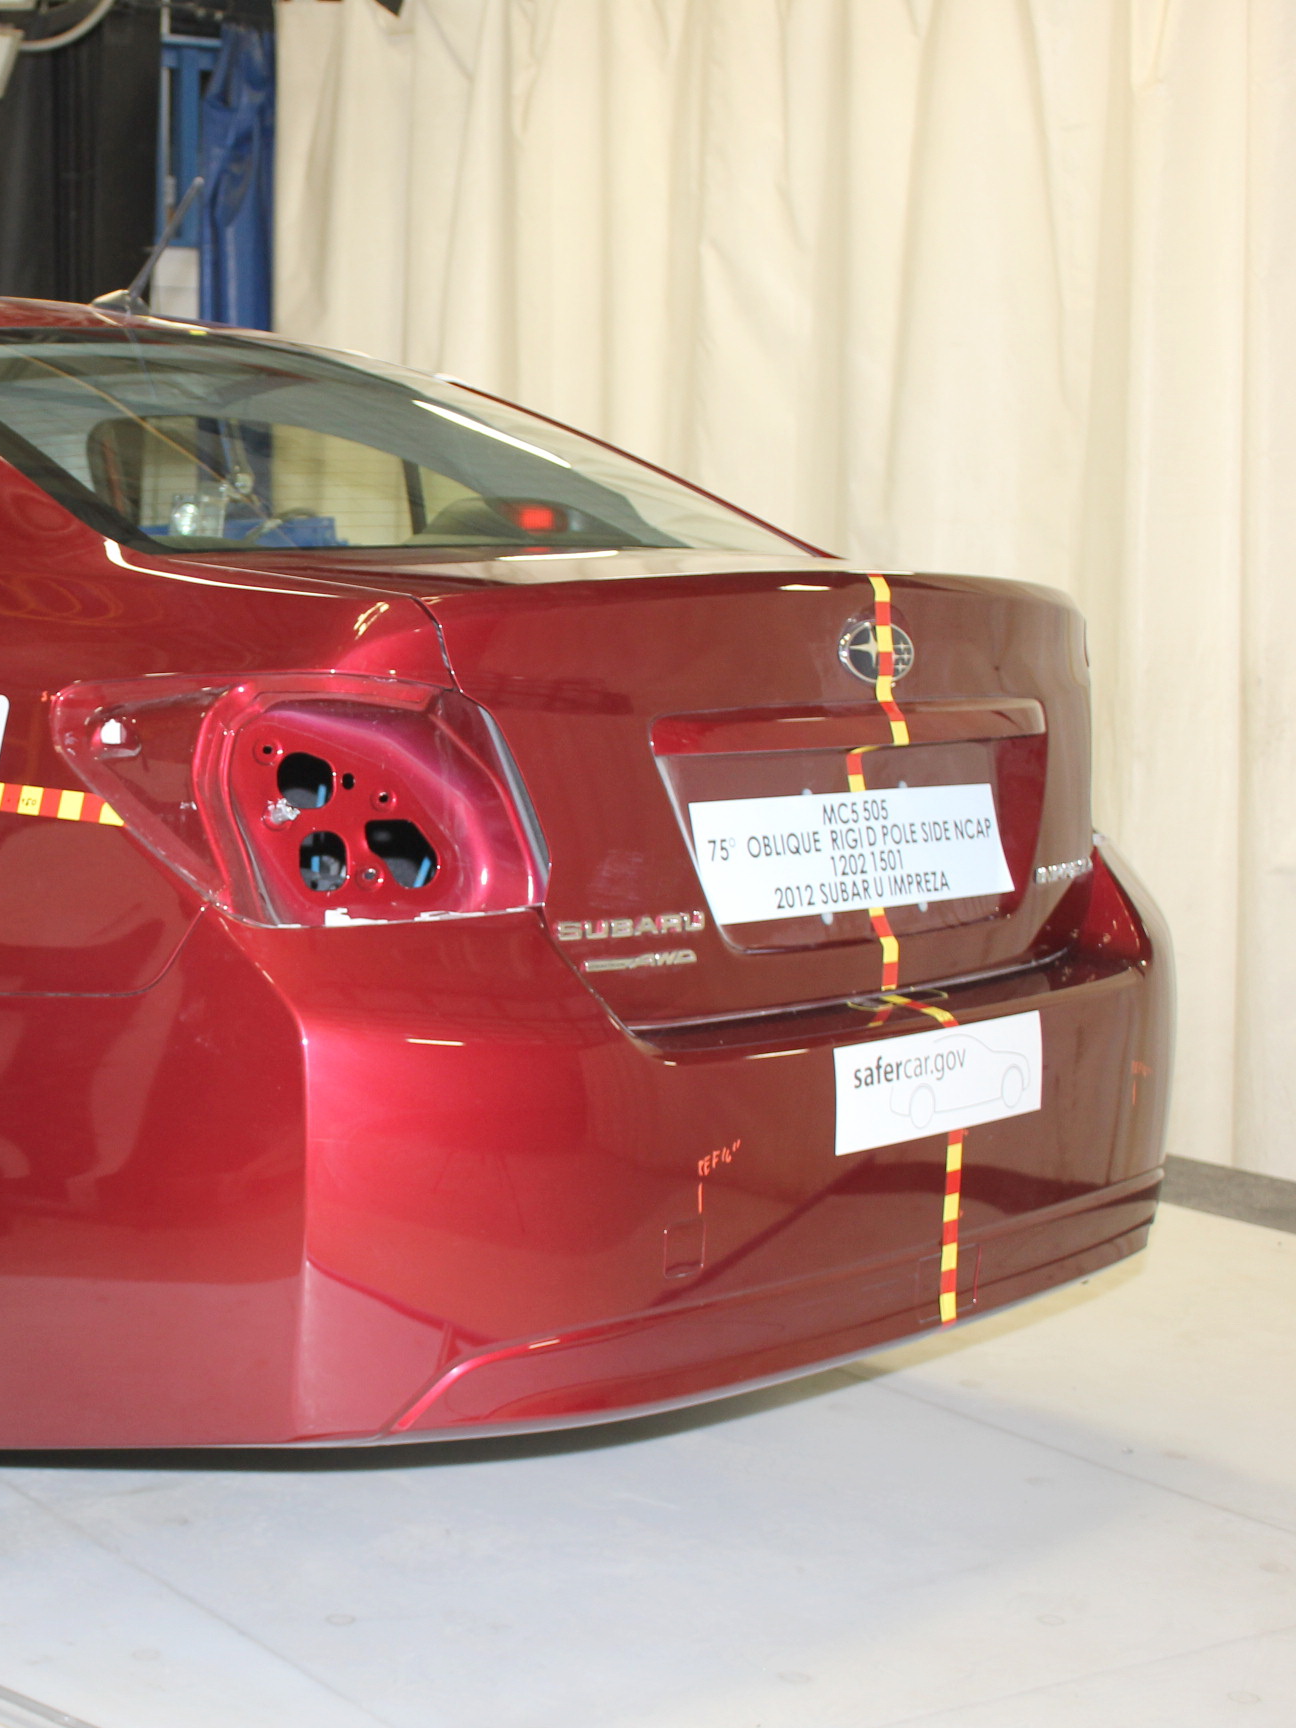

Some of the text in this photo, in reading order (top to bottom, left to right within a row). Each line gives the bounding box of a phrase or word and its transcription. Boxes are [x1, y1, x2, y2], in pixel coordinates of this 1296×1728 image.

[747, 830, 822, 858] OBLIQUE
[882, 822, 917, 847] POLE
[921, 819, 951, 843] SIDE
[954, 817, 992, 841] NCAP
[774, 884, 816, 909] 2012
[889, 870, 951, 897] IMPREZA
[557, 910, 705, 942] SUBARU
[628, 949, 698, 970] AWD
[853, 1047, 967, 1089] safercar.gov
